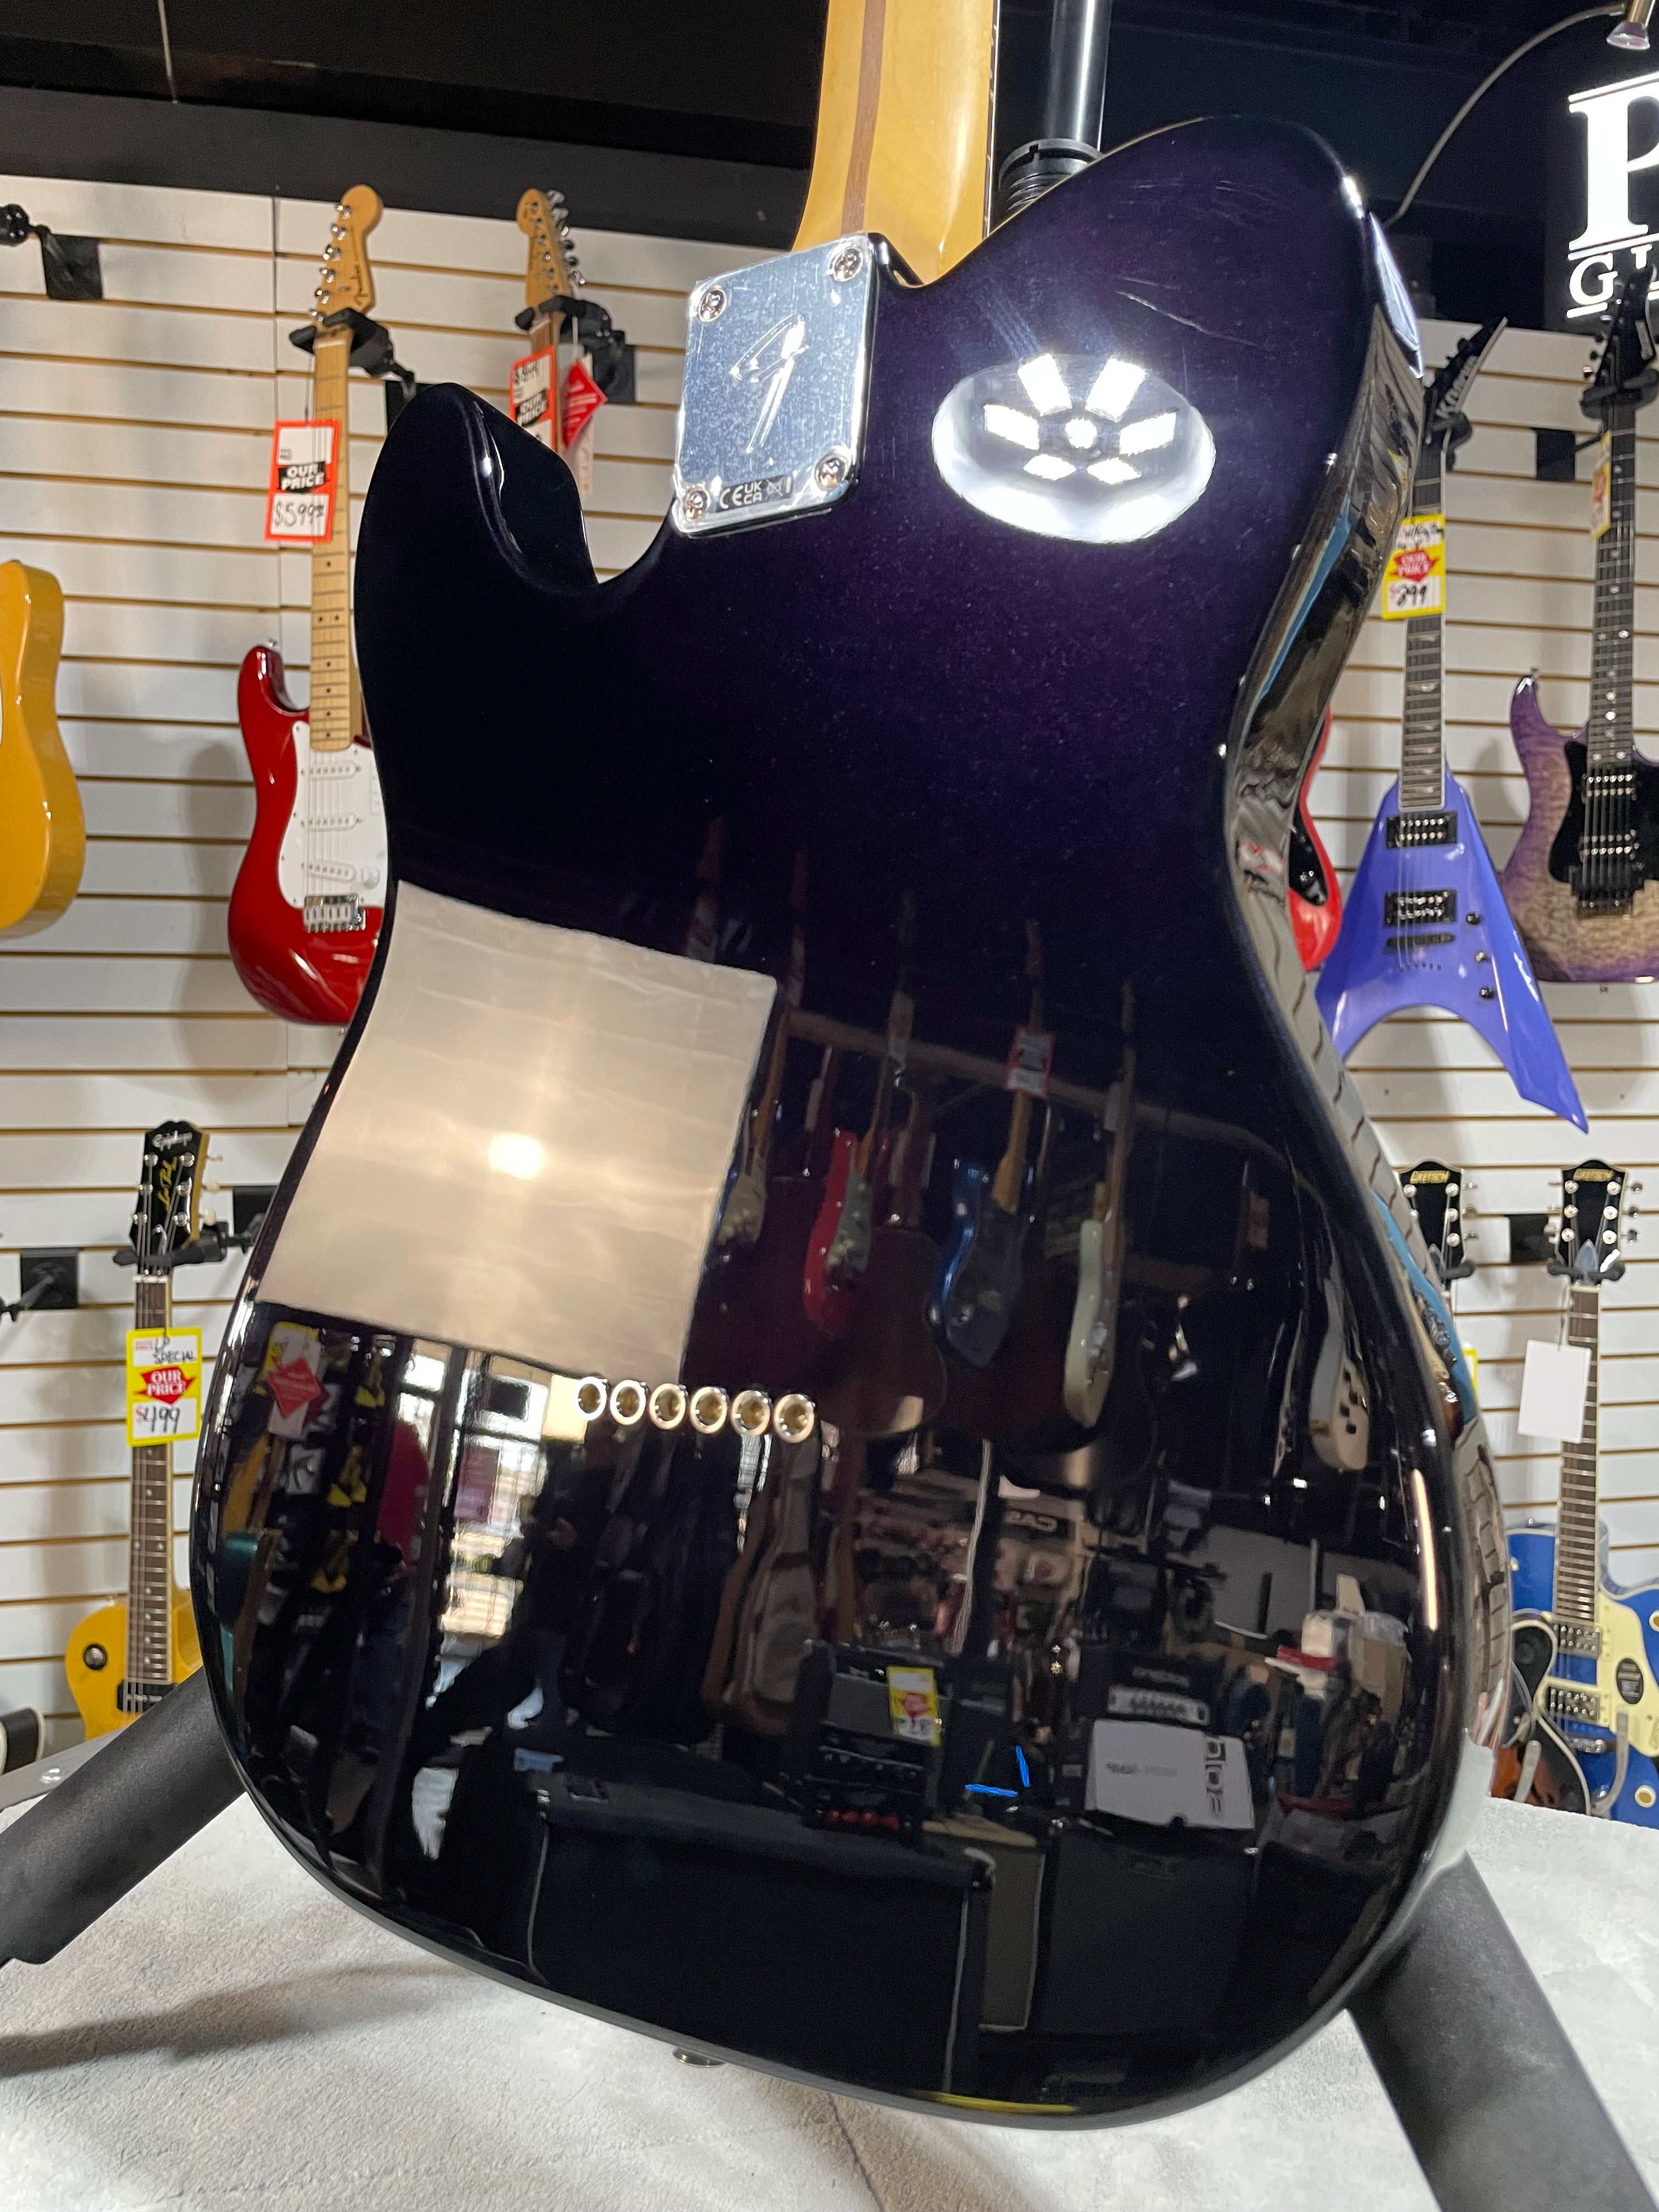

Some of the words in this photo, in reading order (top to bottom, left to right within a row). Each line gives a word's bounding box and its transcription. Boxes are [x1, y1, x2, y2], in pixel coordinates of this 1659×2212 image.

[286, 464, 319, 478] OUR
[281, 473, 325, 490] PRICE
[744, 481, 763, 494] UK
[151, 1369, 182, 1384] OUR
[146, 1380, 188, 1397] PRICE
